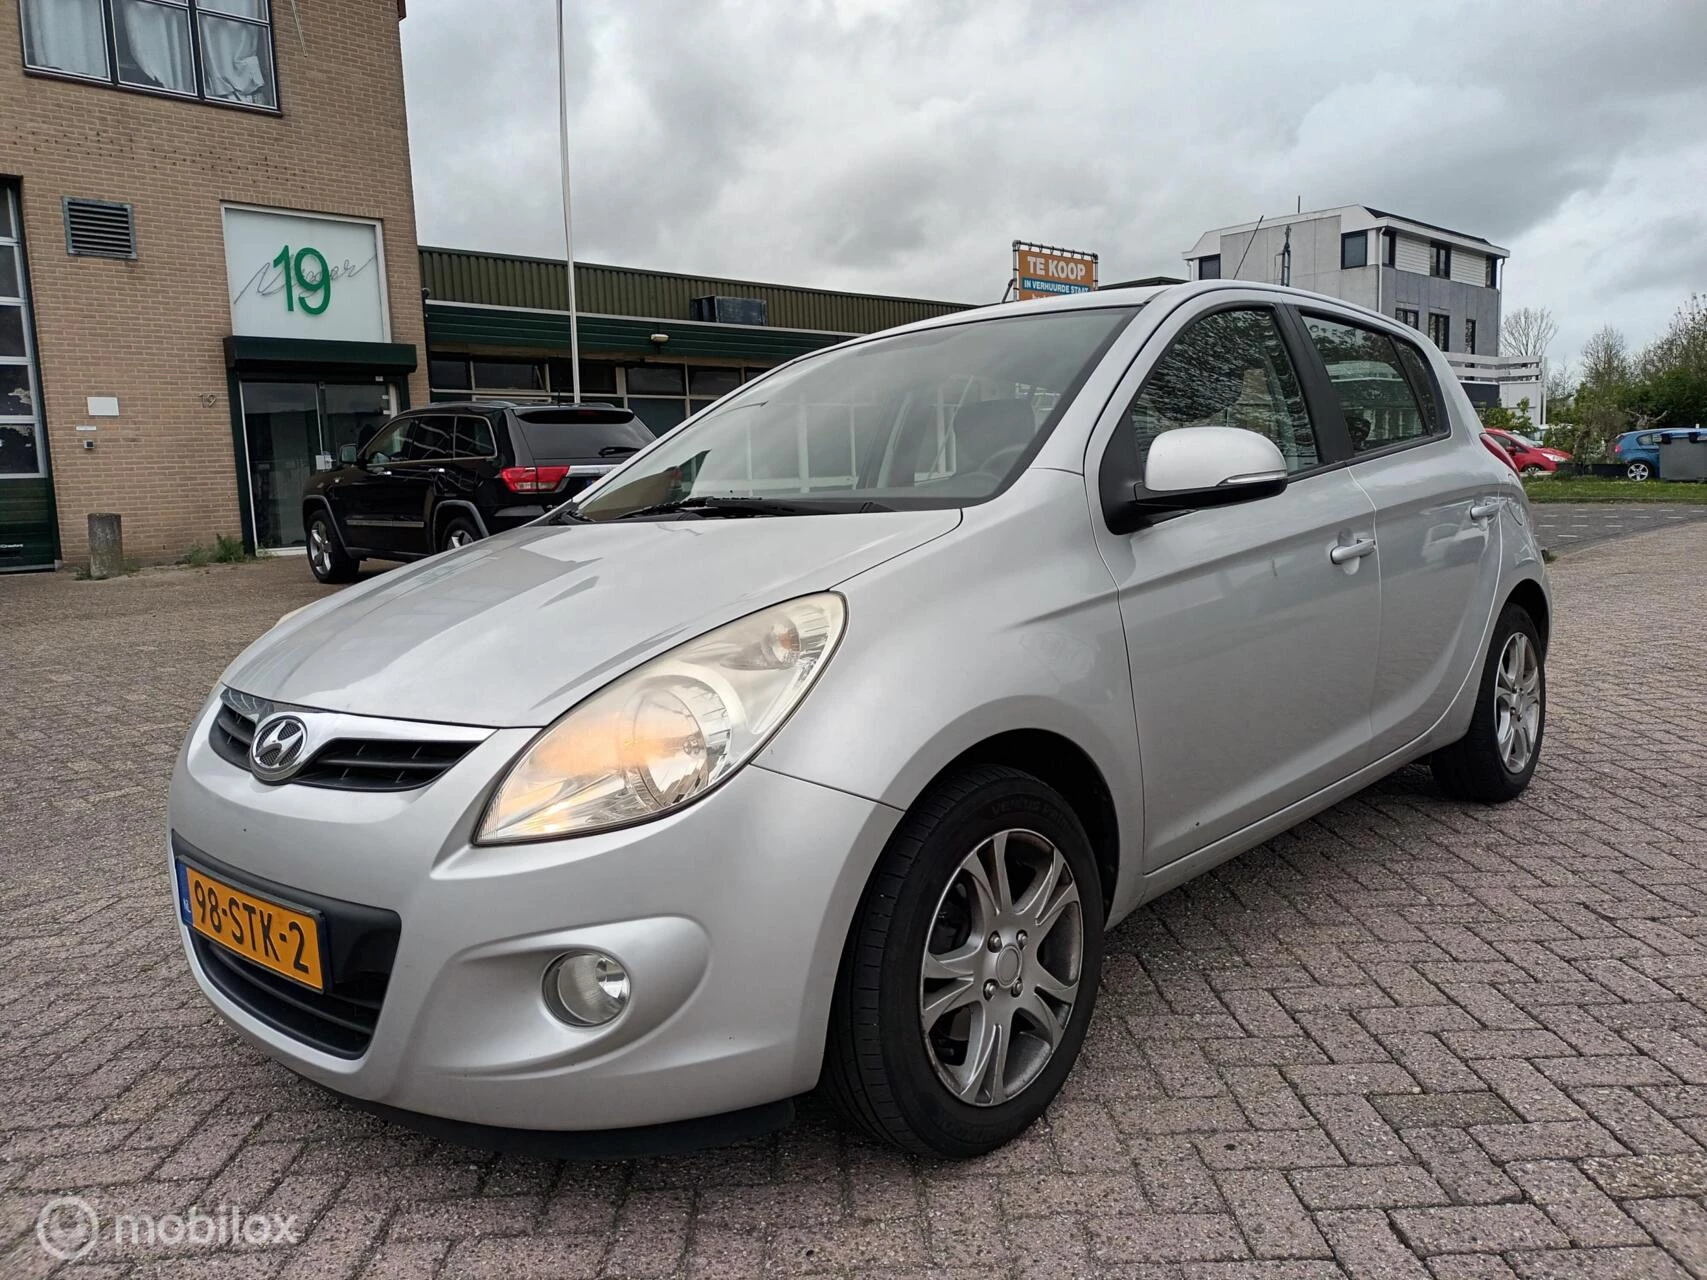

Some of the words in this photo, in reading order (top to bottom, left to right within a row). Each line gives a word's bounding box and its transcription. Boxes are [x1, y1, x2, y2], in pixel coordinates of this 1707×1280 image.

[273, 245, 331, 315] 19
[1023, 279, 1031, 288] IN
[1032, 280, 1070, 294] VERHUURDE
[1027, 256, 1046, 276] TE
[1048, 259, 1086, 280] KOOP
[194, 879, 310, 975] 98-STK-2
